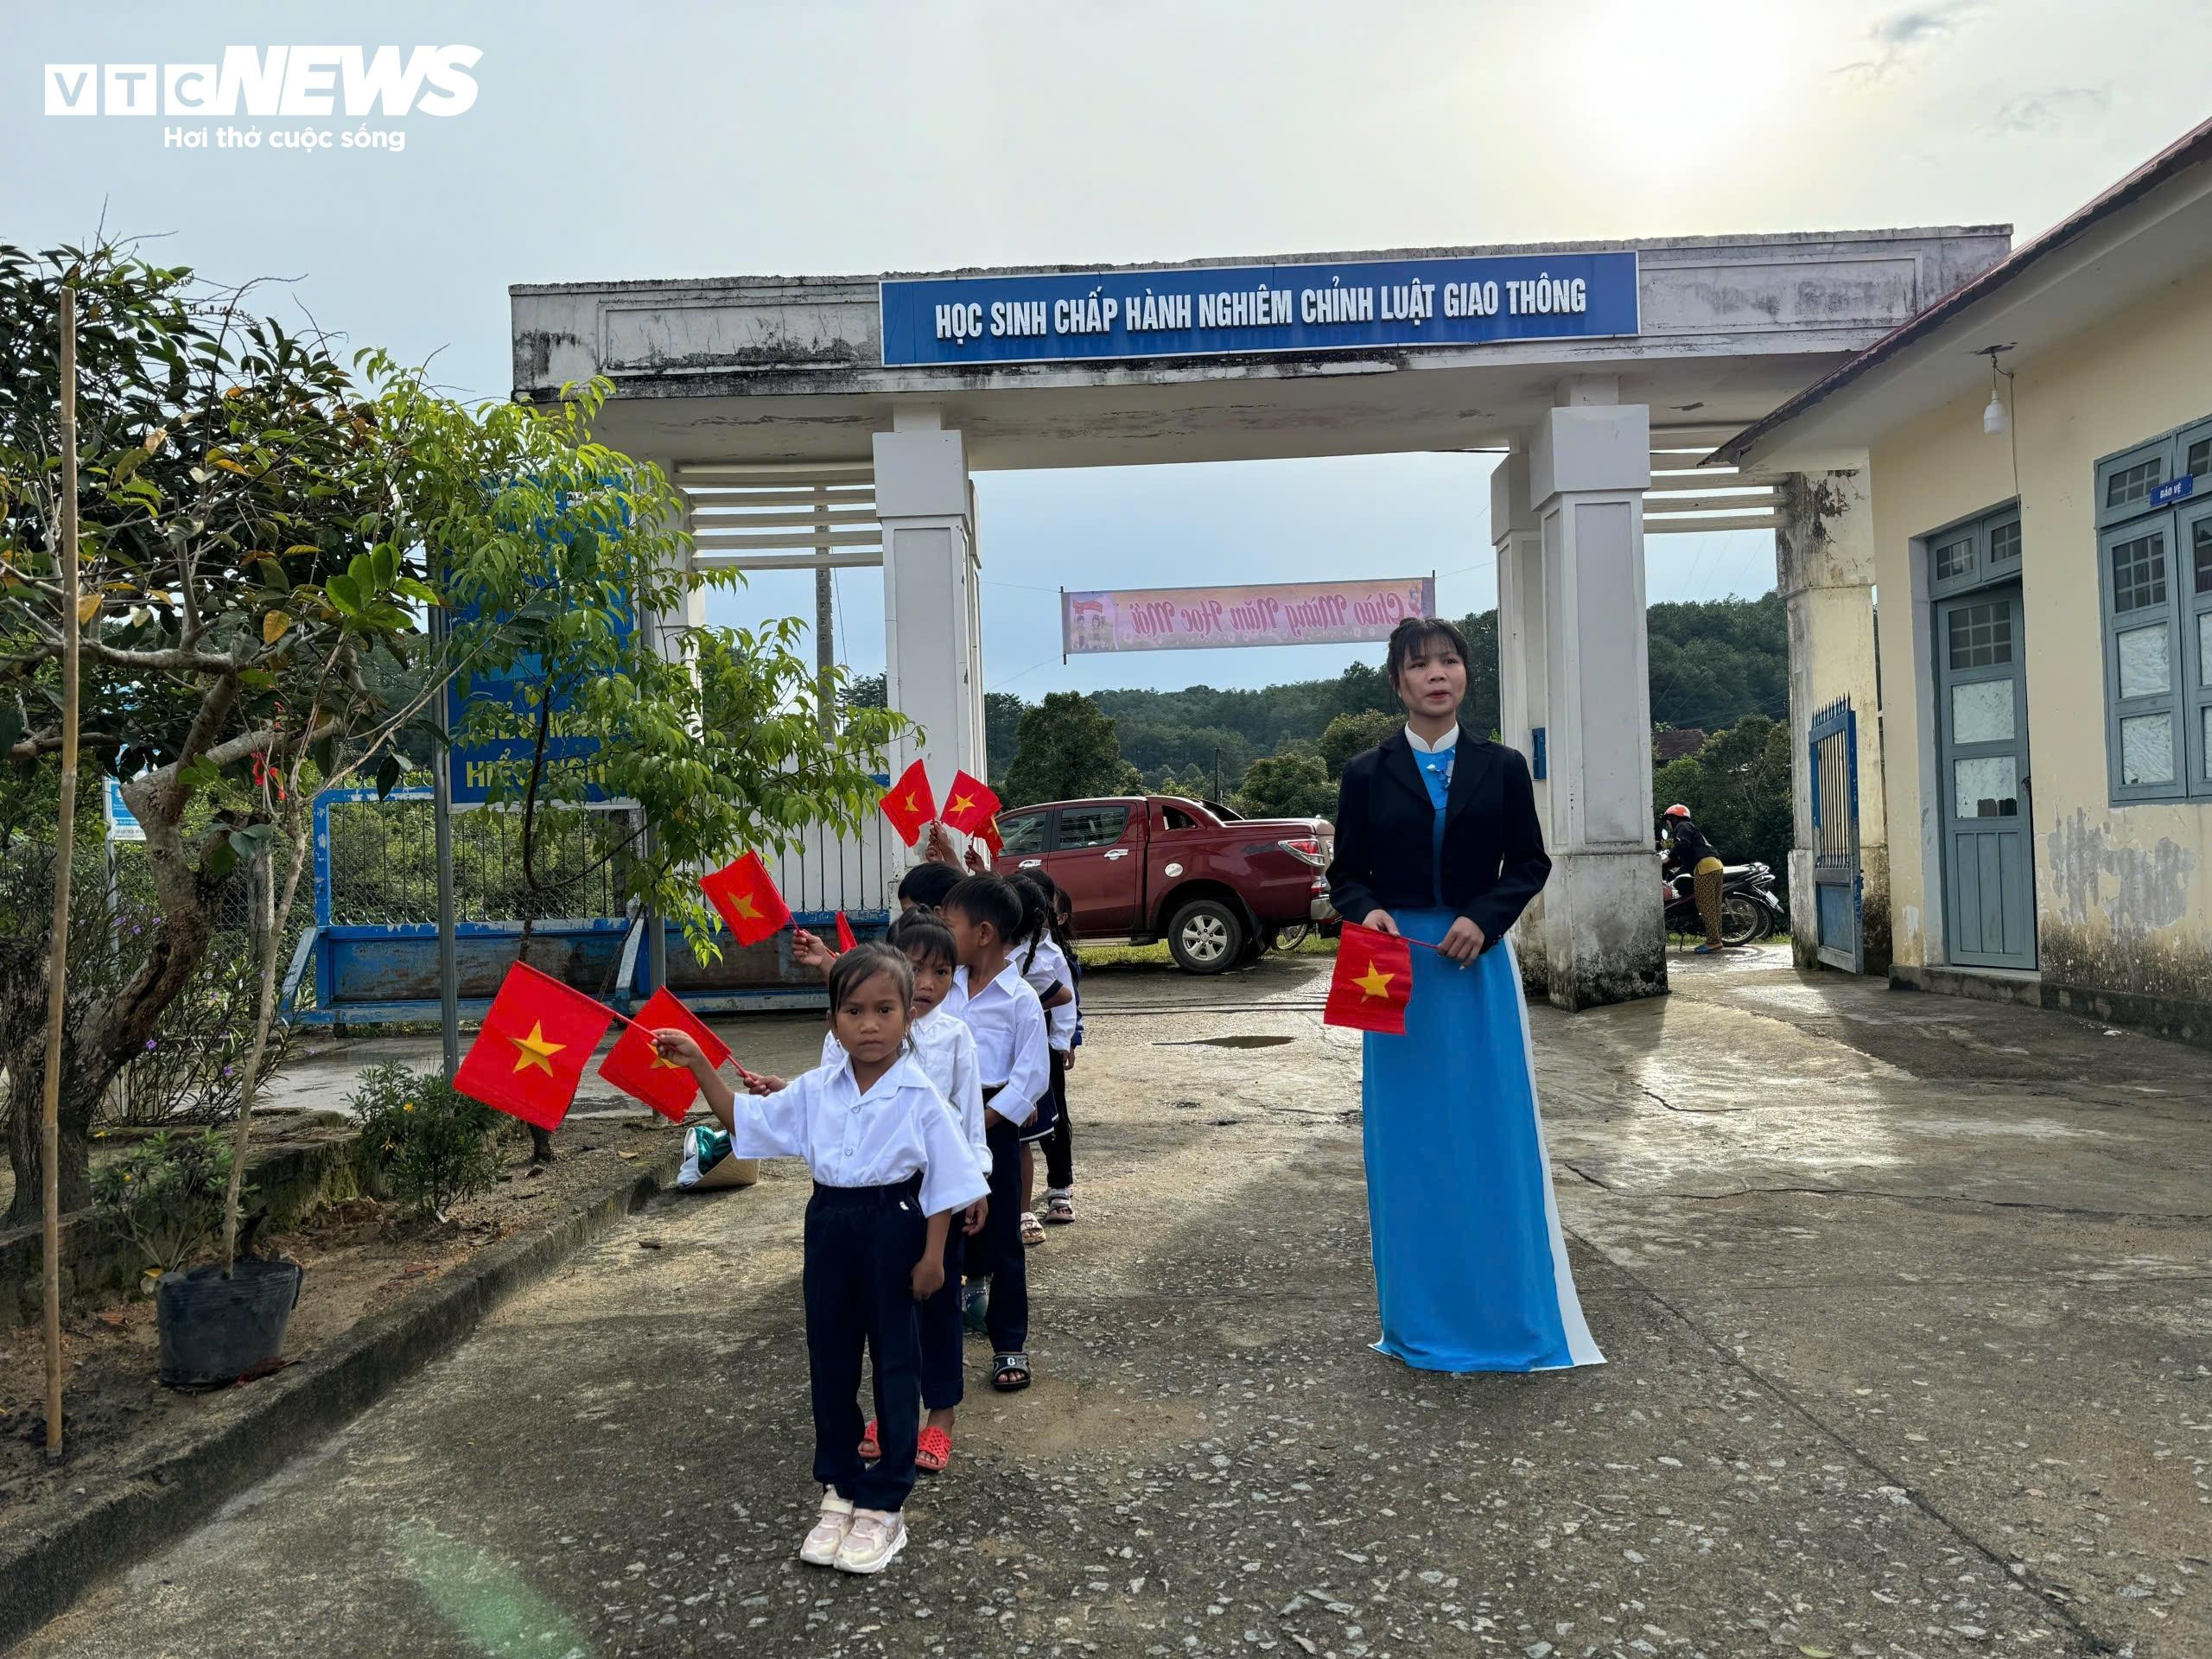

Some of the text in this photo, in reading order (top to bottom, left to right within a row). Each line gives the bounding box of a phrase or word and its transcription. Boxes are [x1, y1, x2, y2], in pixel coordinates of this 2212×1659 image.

[936, 272, 1586, 345] HỌC SINH CHẤP HÀNH NGHIÊM CHỈNH LUẬT GIAO THÔNG
